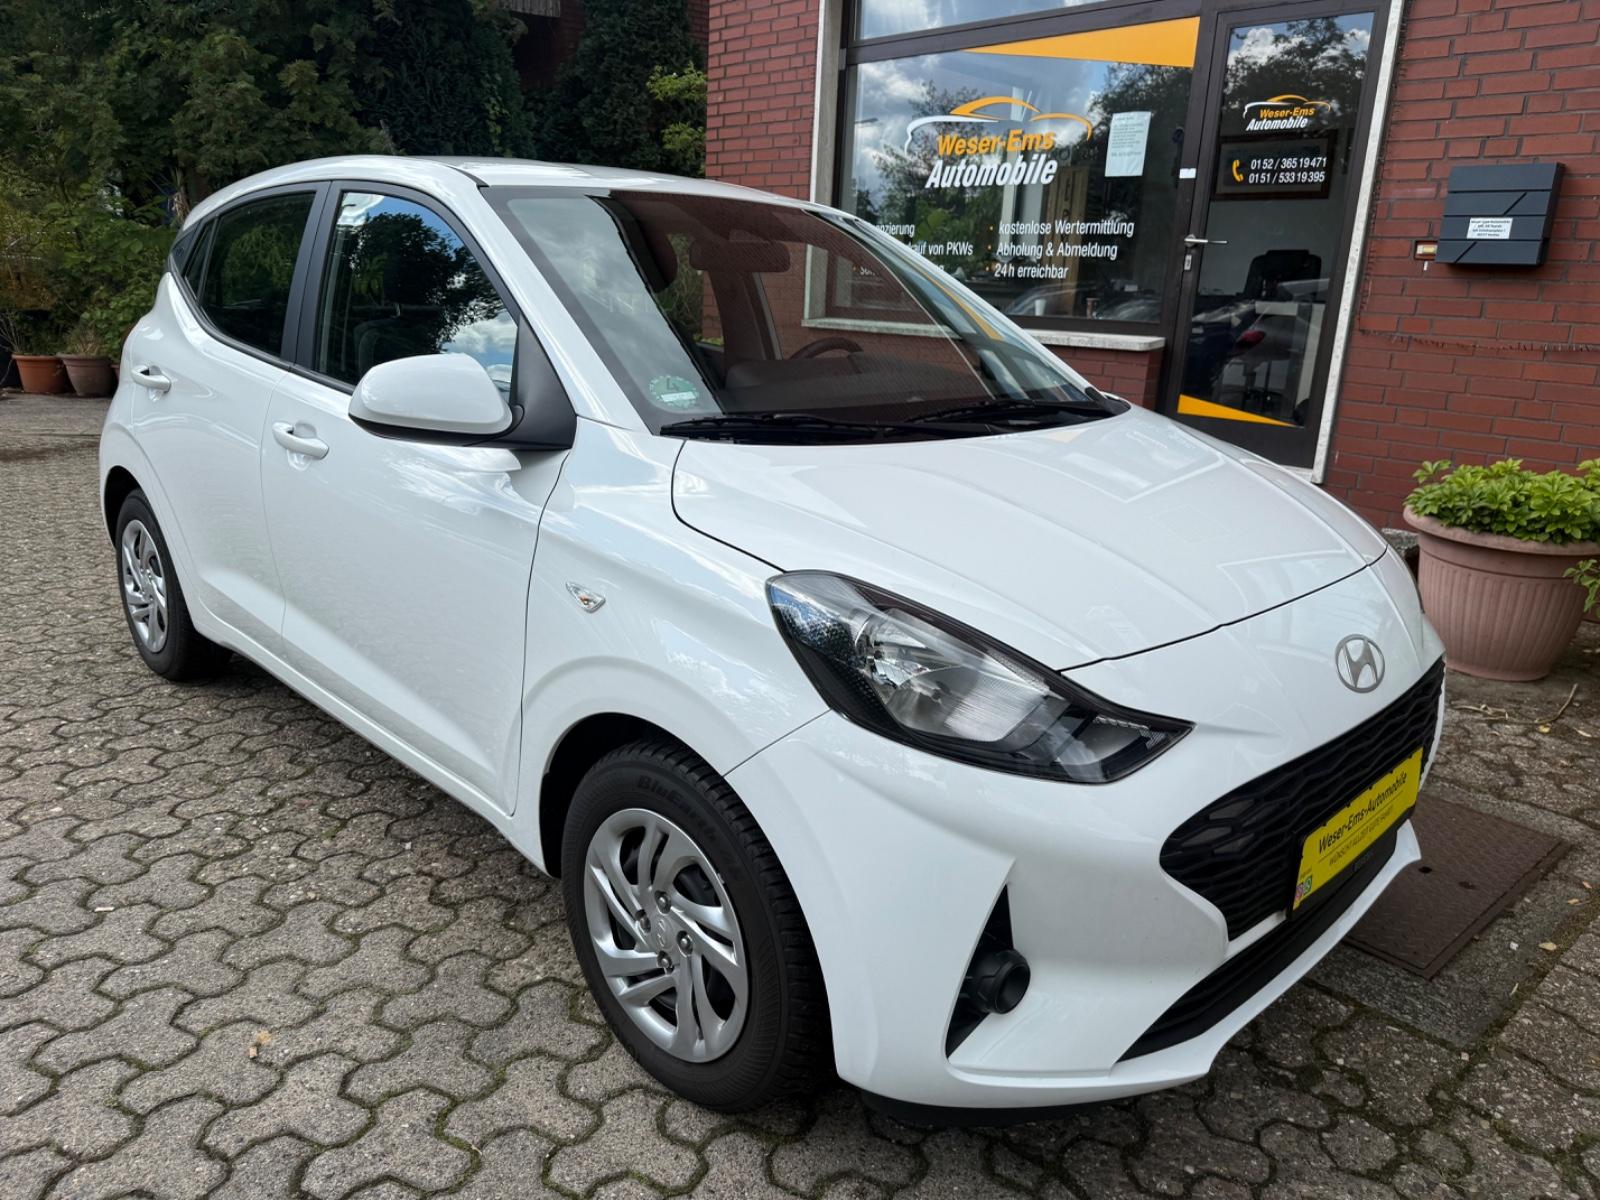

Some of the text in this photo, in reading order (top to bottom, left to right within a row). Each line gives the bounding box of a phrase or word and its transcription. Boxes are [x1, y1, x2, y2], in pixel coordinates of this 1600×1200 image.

[1260, 107, 1315, 118] Weser-Ems
[1246, 116, 1307, 131] Automobile
[937, 129, 1056, 156] Weser-Ems
[924, 153, 1058, 189] Automobile
[999, 219, 1135, 238] kostenlose Wertermittlung
[929, 245, 946, 256] von
[946, 241, 974, 256] PKWs
[996, 241, 1118, 260] Abholung & Abmeldung
[1017, 263, 1069, 279] erreichbar
